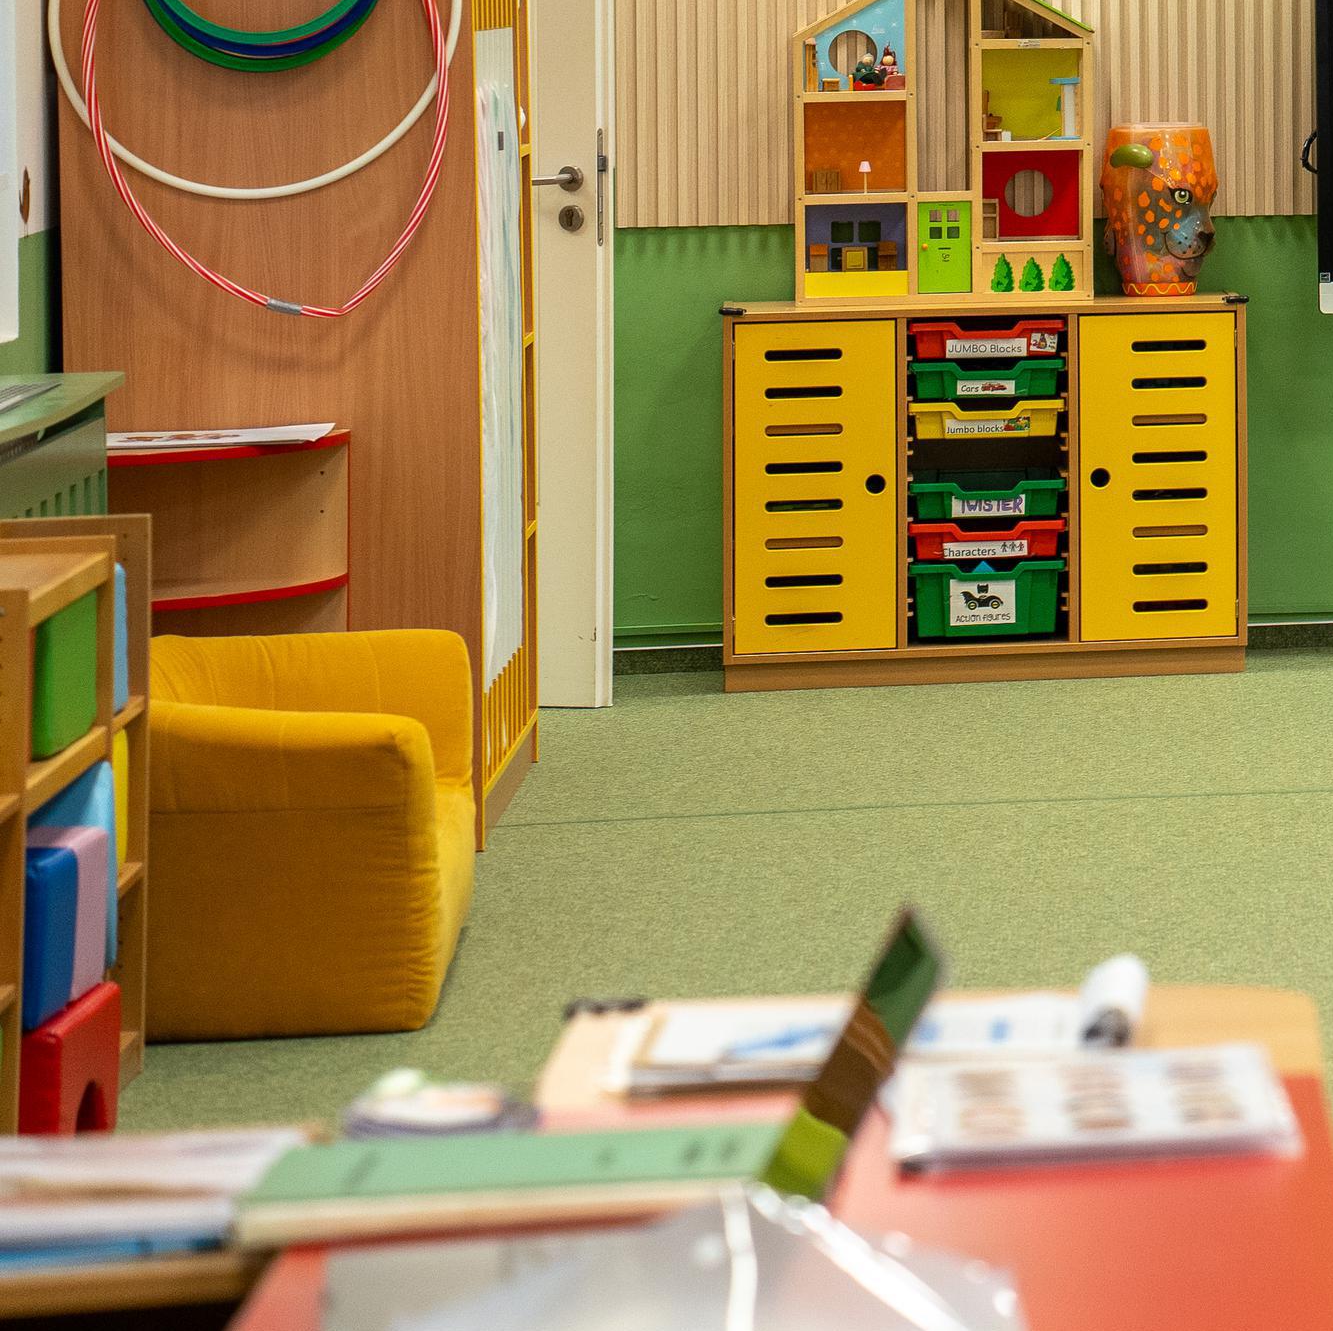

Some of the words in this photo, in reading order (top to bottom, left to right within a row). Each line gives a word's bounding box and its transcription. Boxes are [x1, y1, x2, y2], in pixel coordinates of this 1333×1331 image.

[948, 344, 987, 354] JUMBO
[990, 343, 1022, 353] Blocks
[961, 384, 979, 393] Cars
[947, 425, 975, 434] Jumbo
[976, 423, 1004, 433] blocks
[962, 496, 1023, 514] TWISTER
[944, 548, 997, 557] Characters
